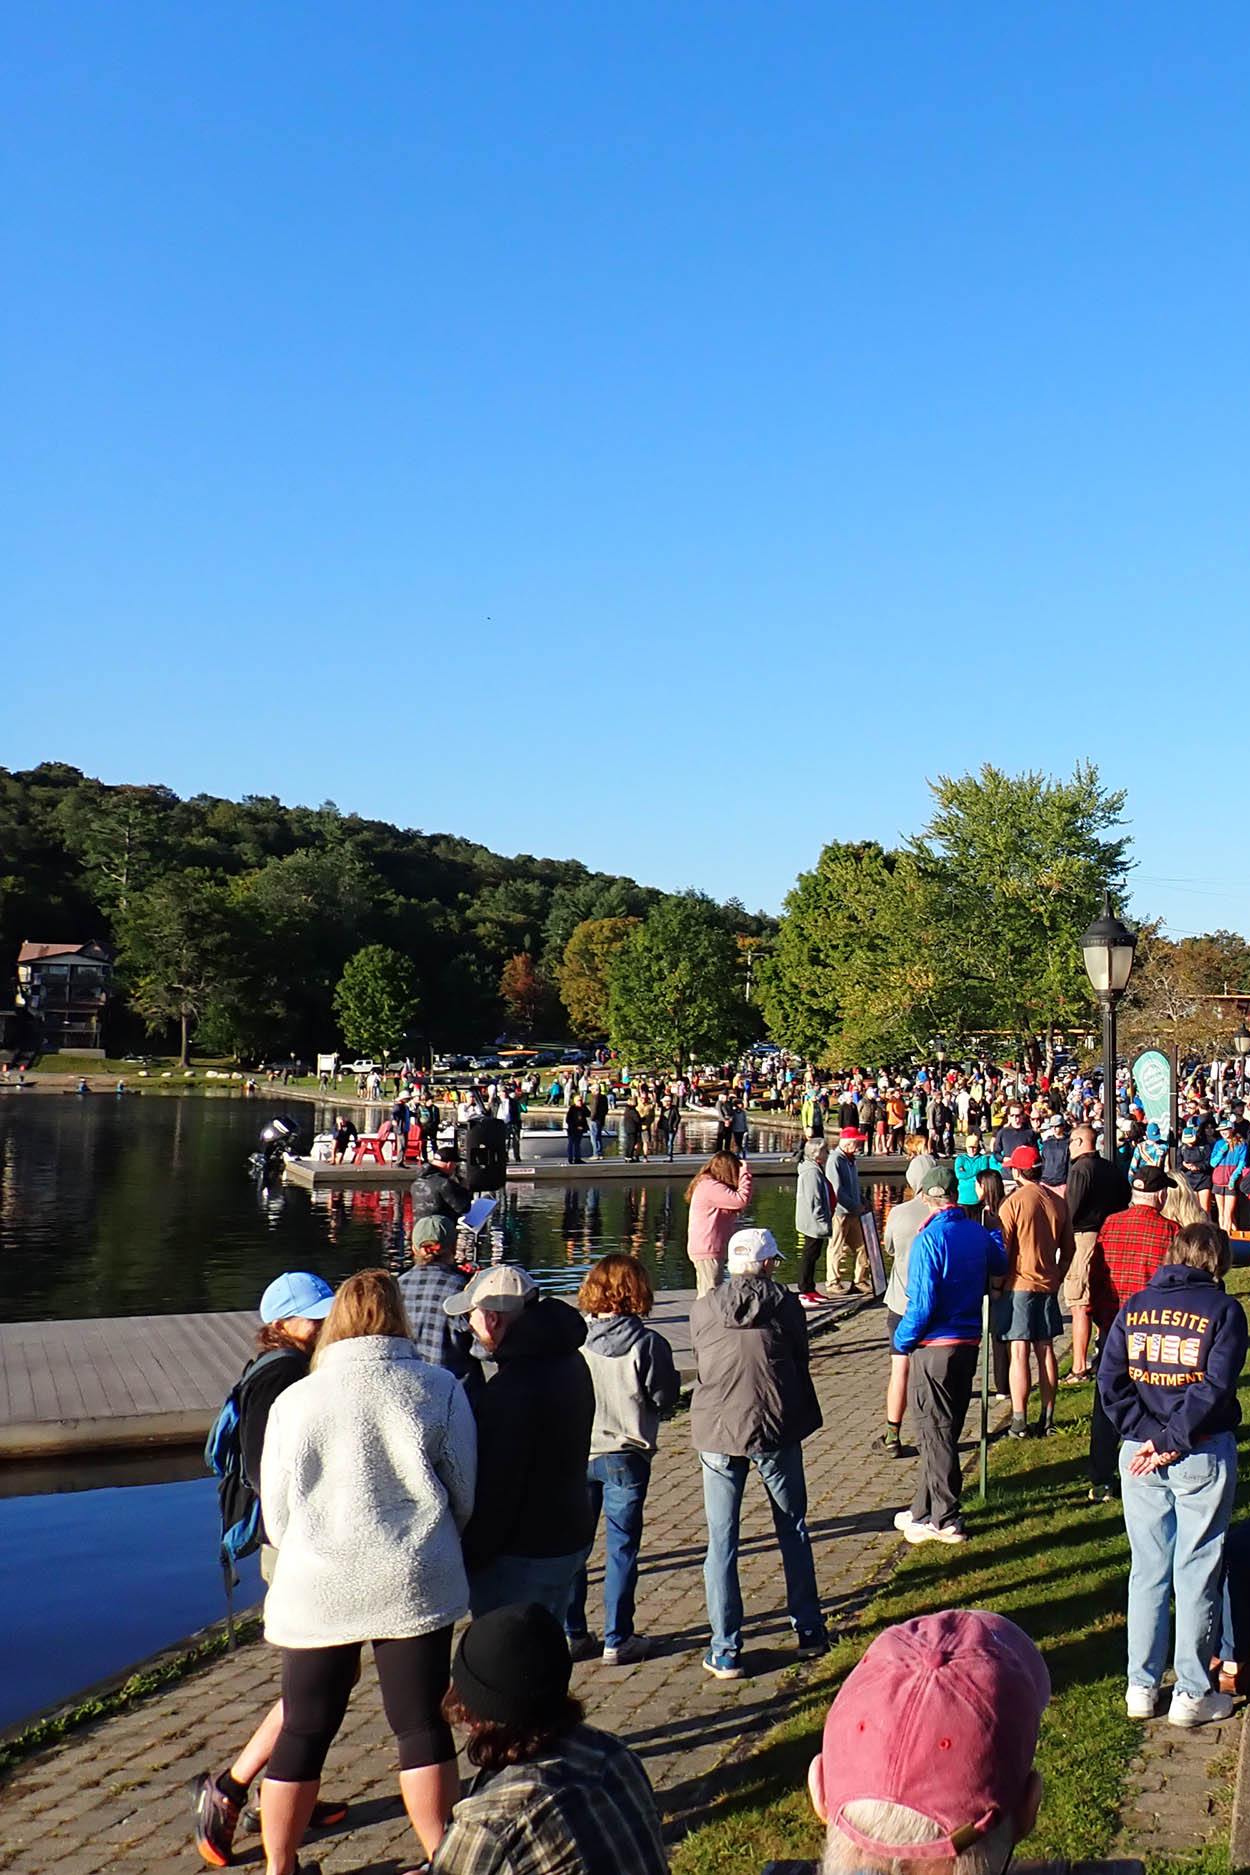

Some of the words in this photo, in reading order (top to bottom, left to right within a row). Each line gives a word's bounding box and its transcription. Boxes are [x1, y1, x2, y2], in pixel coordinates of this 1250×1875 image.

[1126, 1310, 1209, 1333] HALESITE
[1128, 1332, 1200, 1366] FIRE
[1128, 1366, 1204, 1386] EPARTMENT
